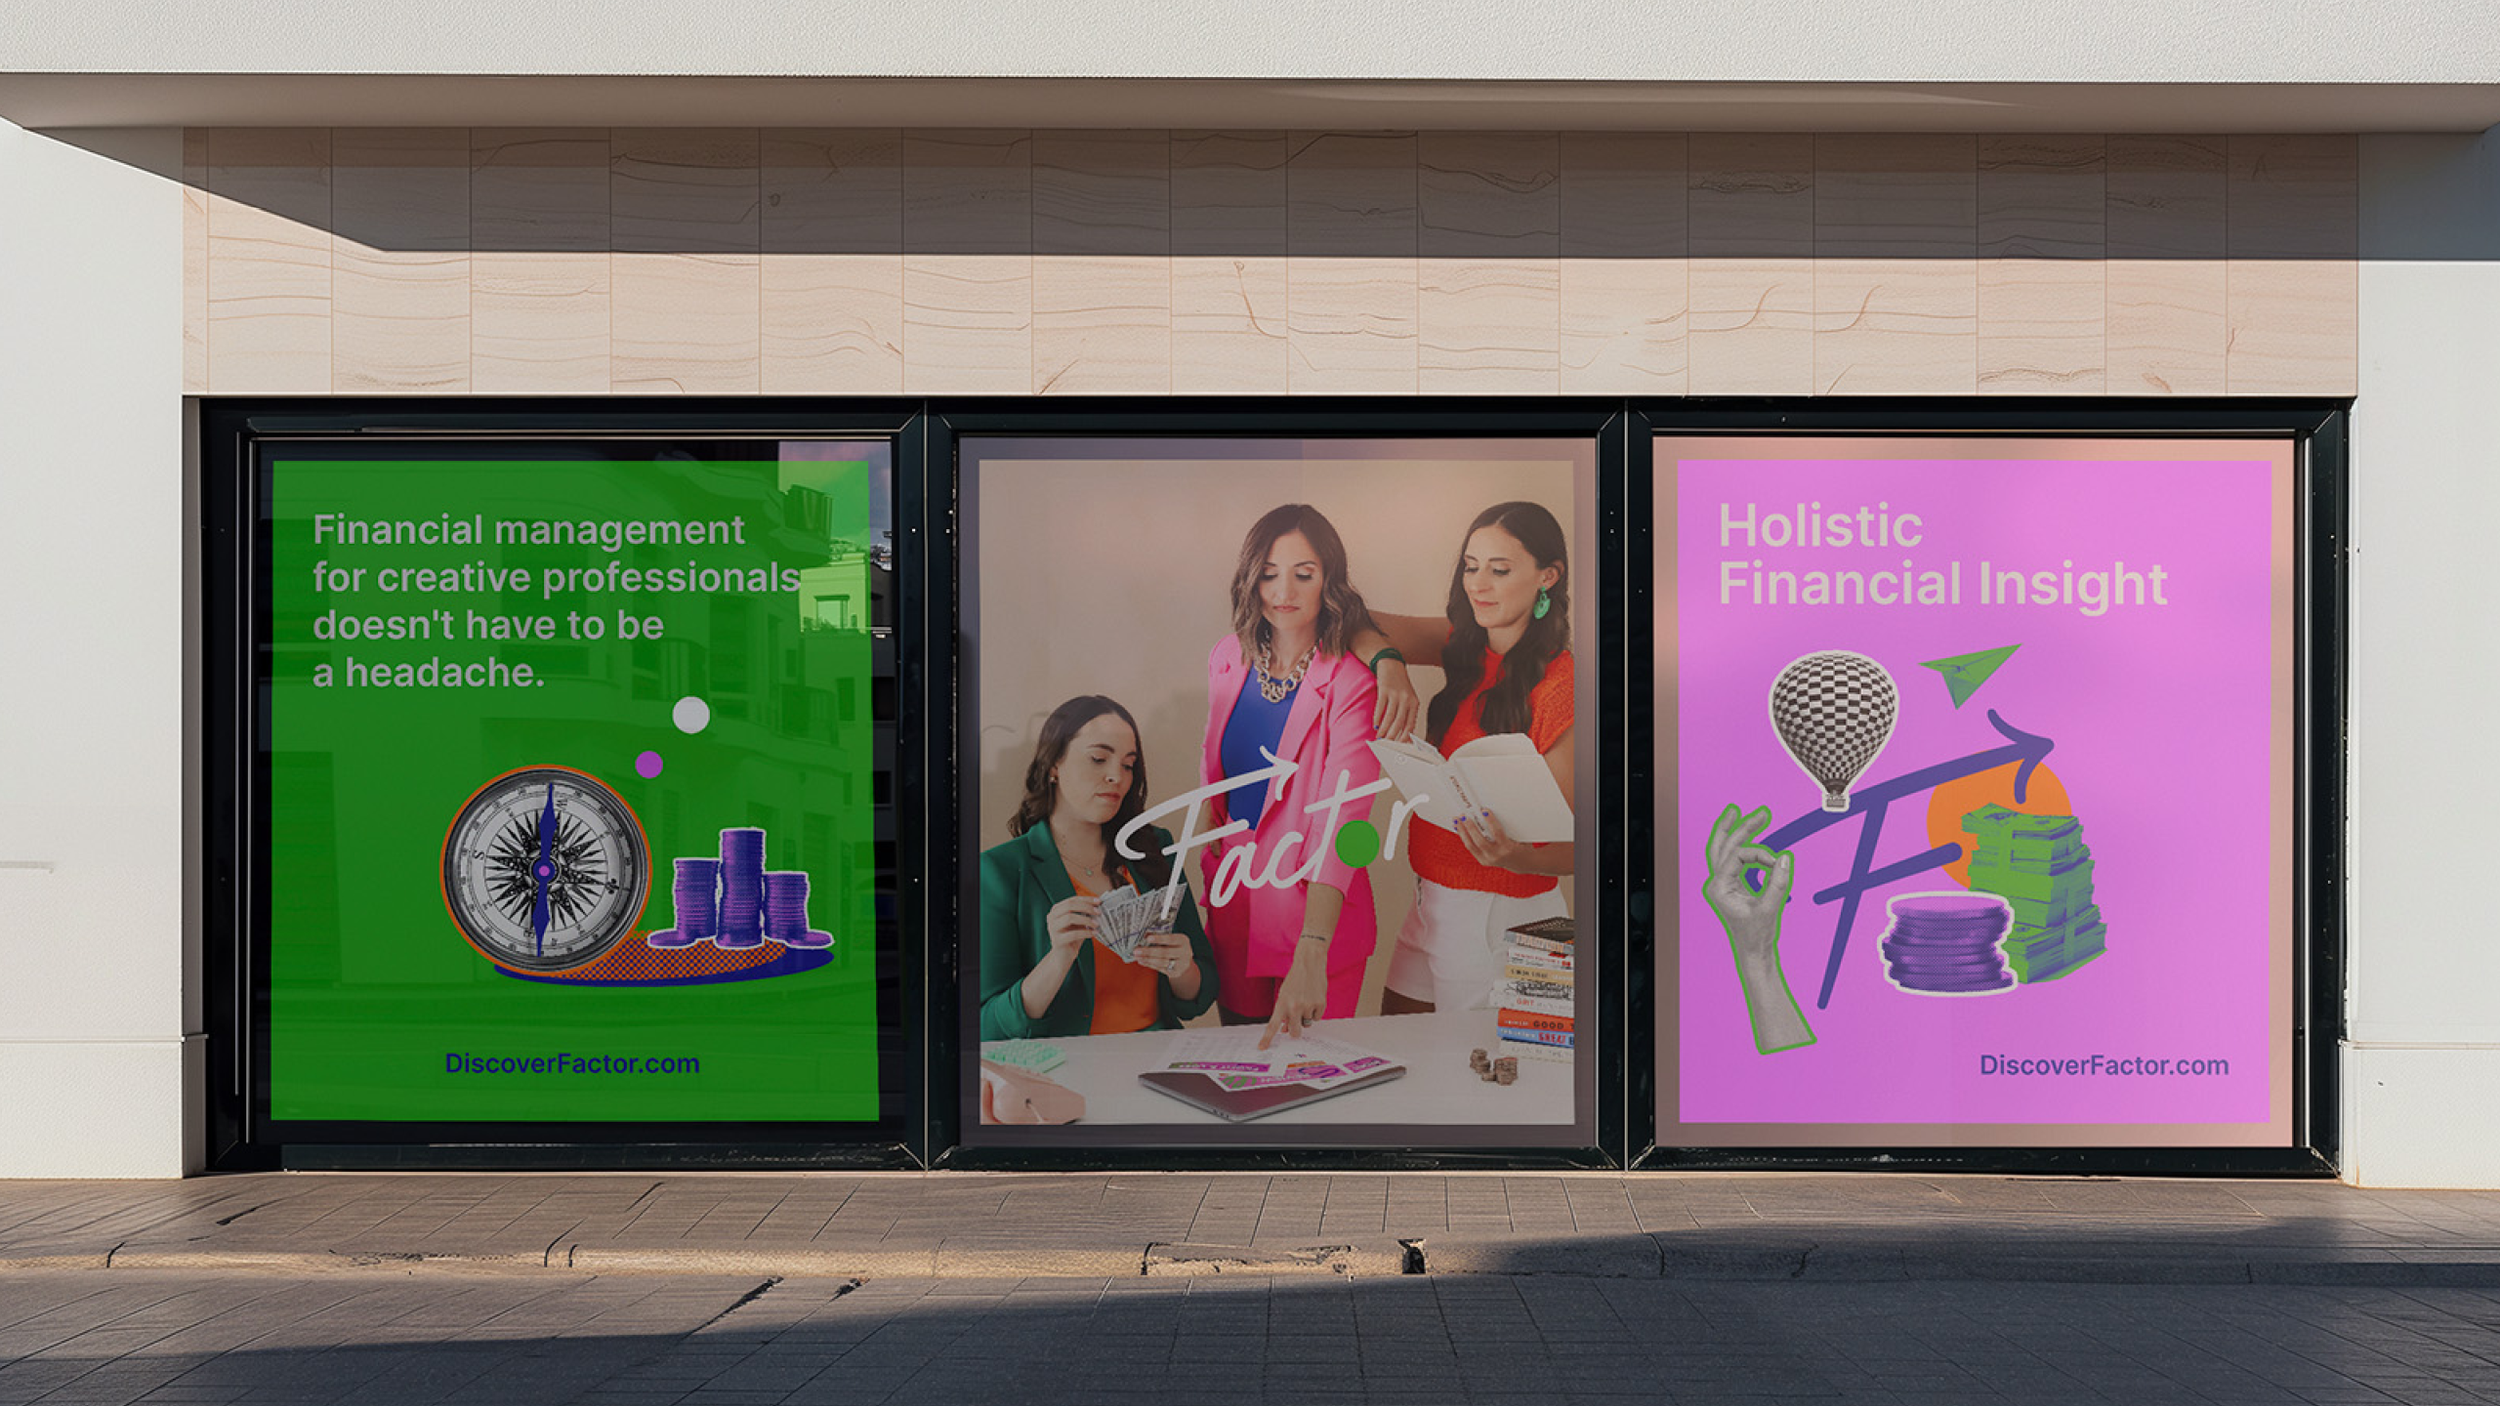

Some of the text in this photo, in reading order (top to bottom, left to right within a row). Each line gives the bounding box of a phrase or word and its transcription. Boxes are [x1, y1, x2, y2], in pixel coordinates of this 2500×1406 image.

[314, 513, 746, 552] Financial management
[1720, 501, 1923, 548] Holistic
[313, 561, 801, 600] for creative professionals
[1720, 559, 2169, 617] Financial Insight
[314, 610, 664, 640] doesn't have to be
[313, 657, 545, 688] a headache.
[1533, 1020, 1565, 1030] GOOD
[1538, 1032, 1566, 1045] GREAT
[446, 1052, 700, 1074] DiscoverFactor.com
[1980, 1053, 2229, 1076] DiscoverFactor.com
